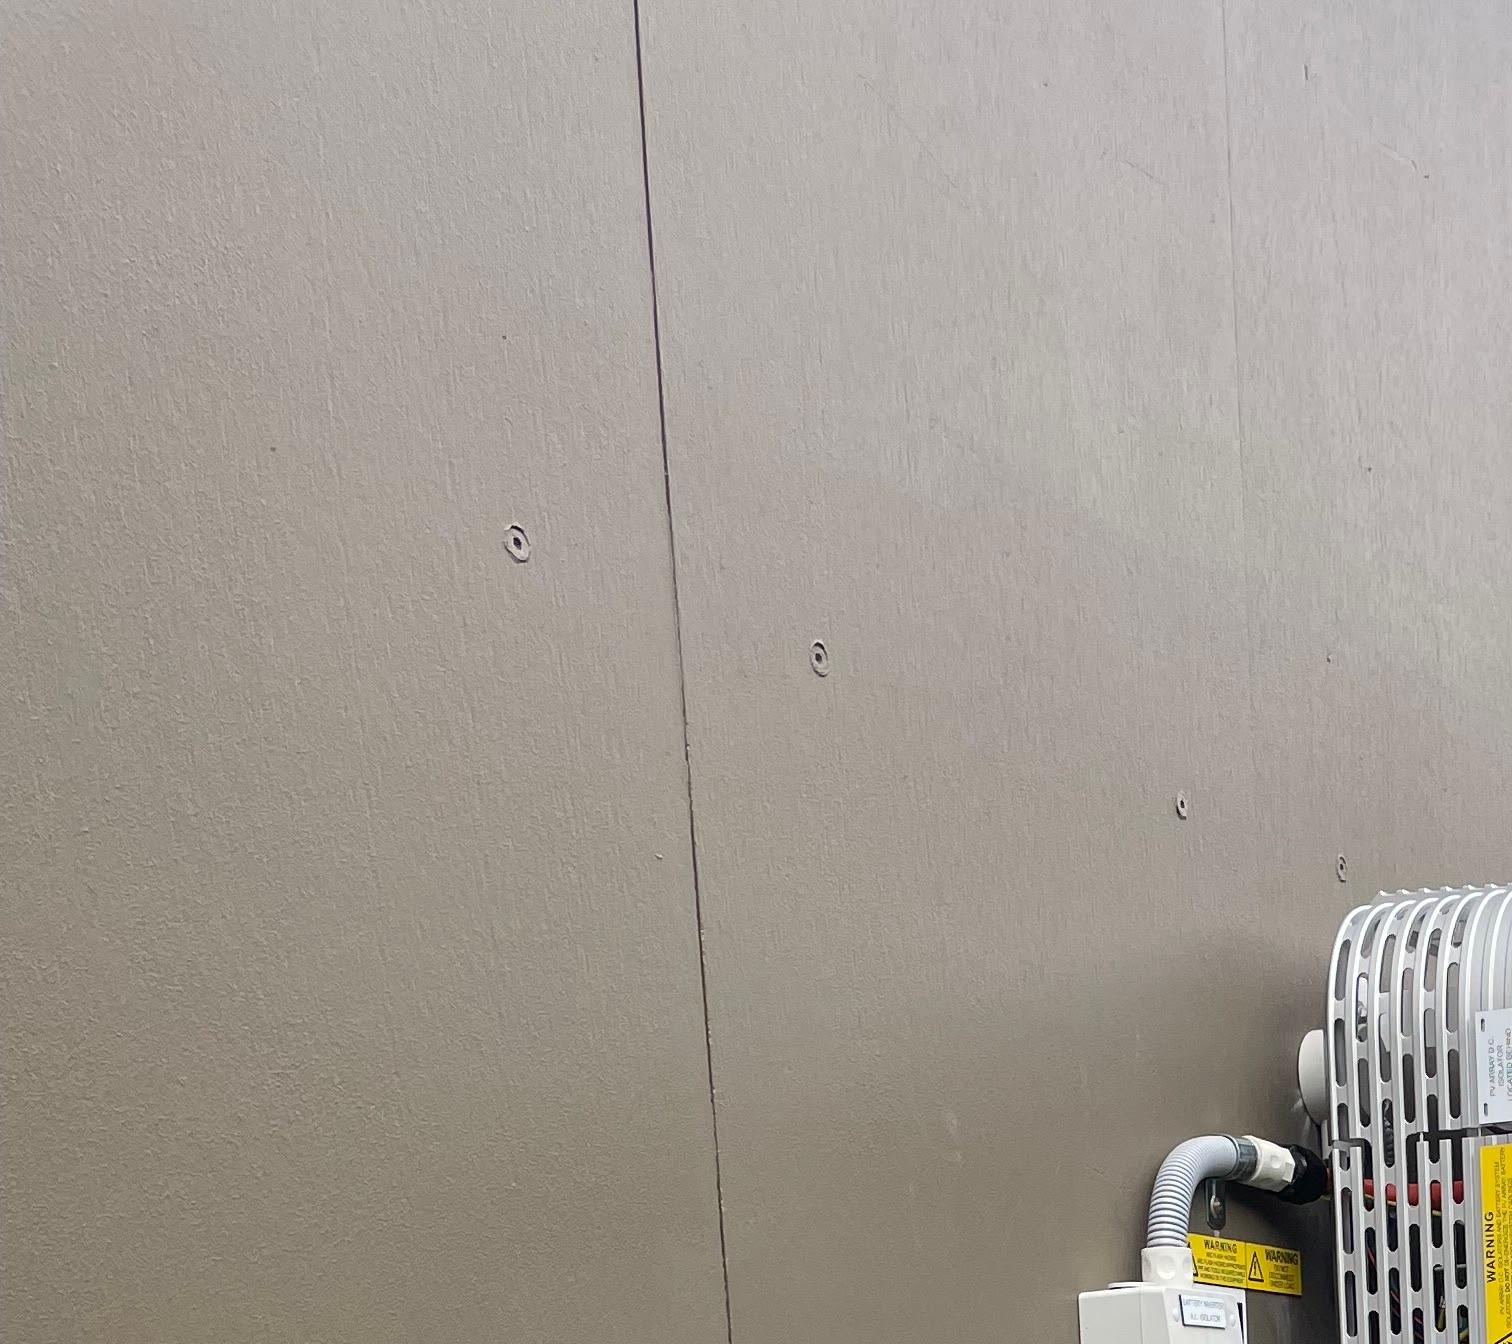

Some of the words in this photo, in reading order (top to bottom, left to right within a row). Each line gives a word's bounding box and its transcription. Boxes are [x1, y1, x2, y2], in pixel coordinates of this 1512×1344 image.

[1504, 1027, 1512, 1061] BEHIND
[1496, 1044, 1505, 1087] ISOLATOR
[1203, 1239, 1237, 1254] WARNING
[1264, 1248, 1299, 1266] WARNING
[1484, 1211, 1496, 1283] WARNING
